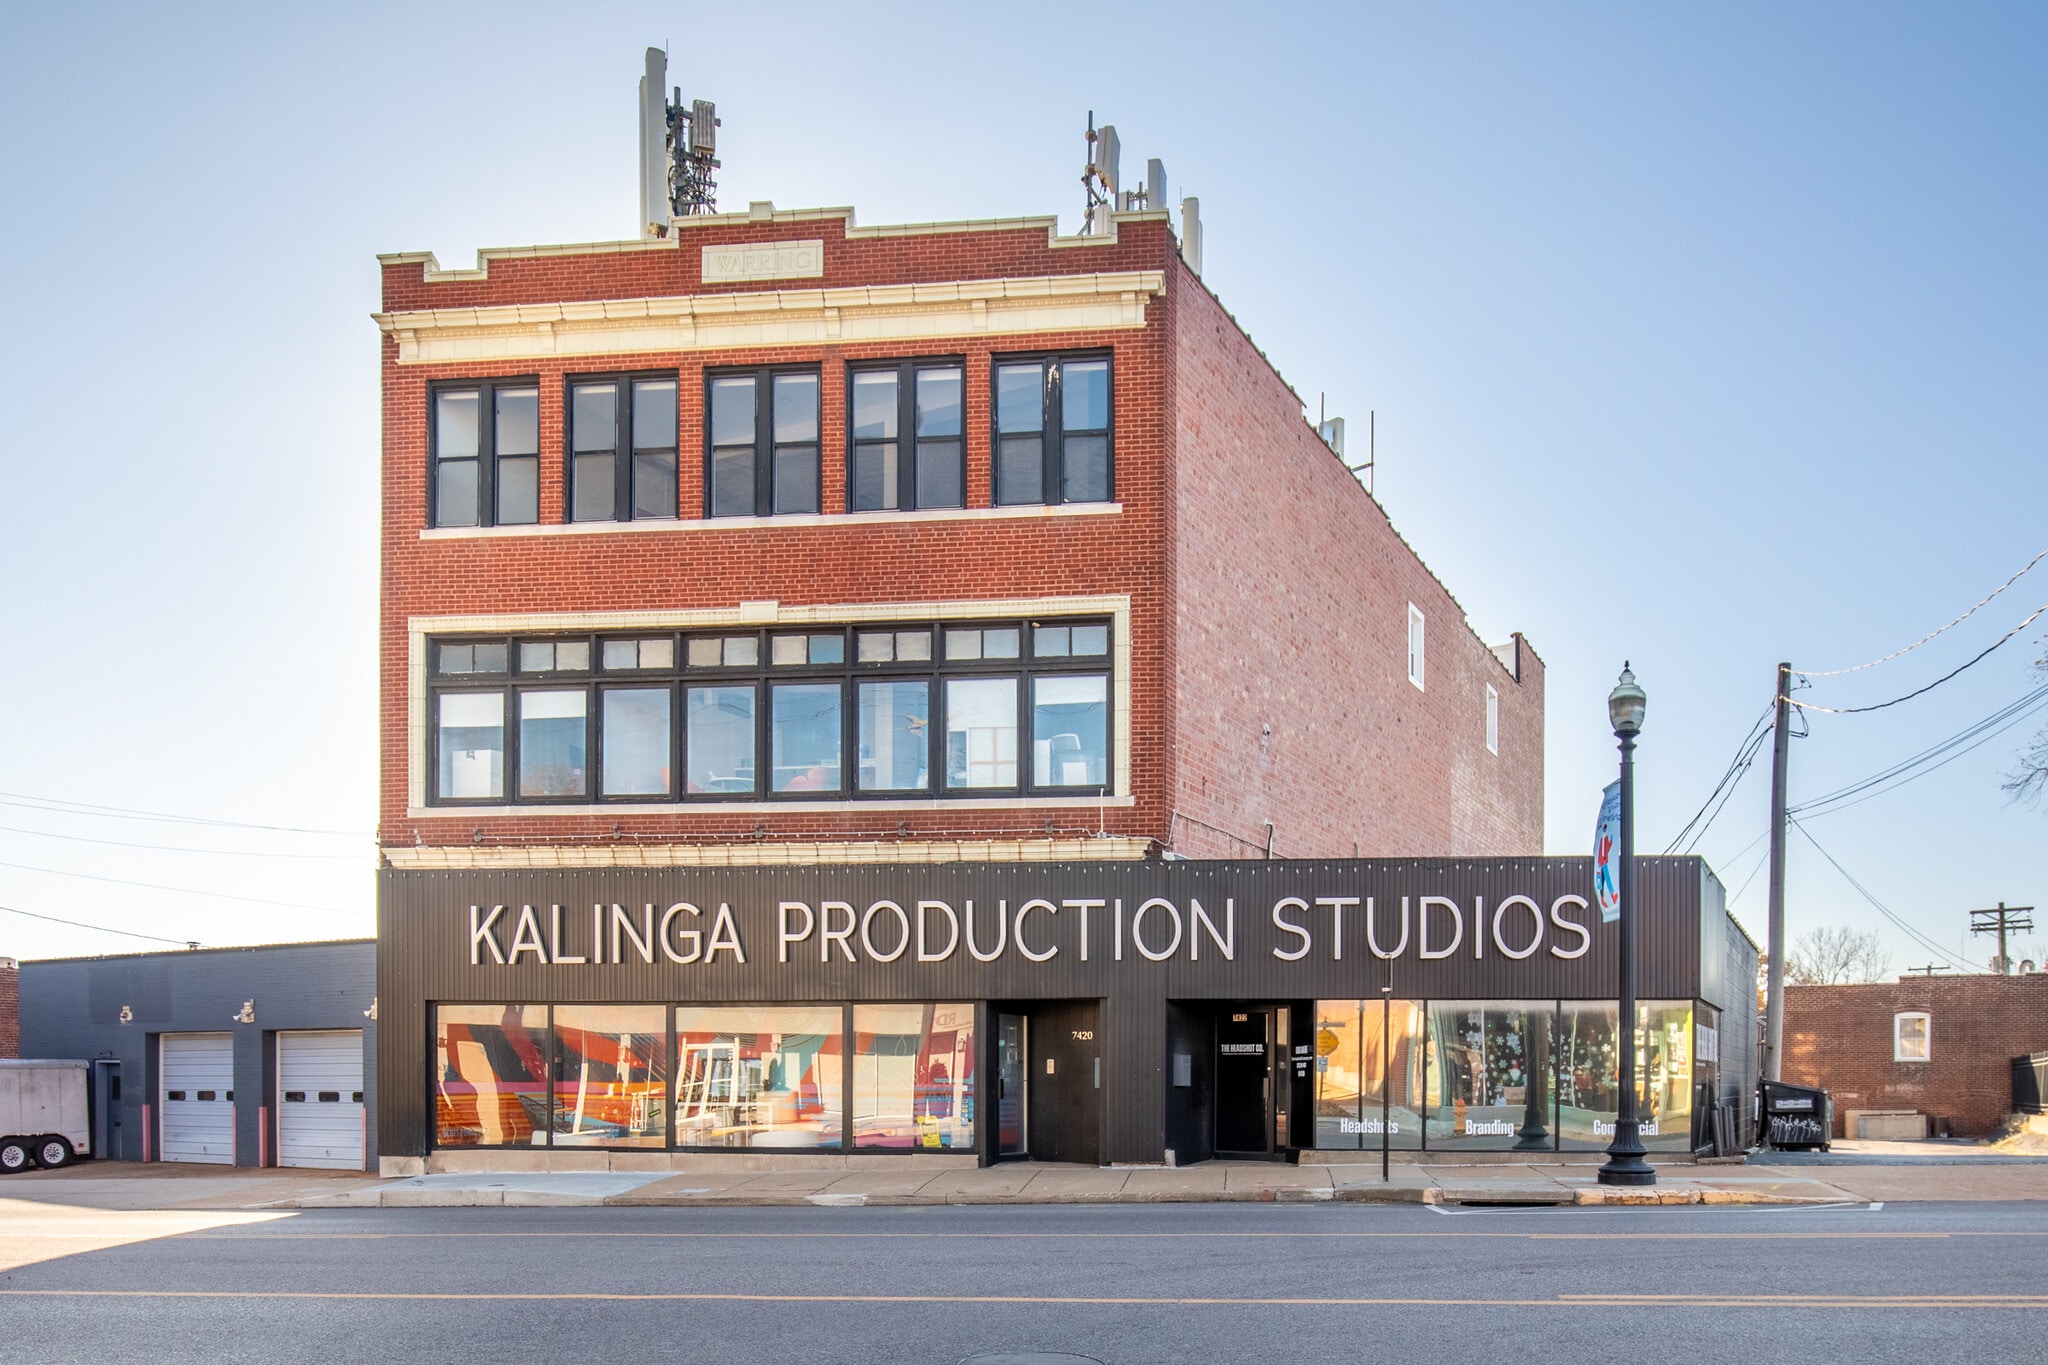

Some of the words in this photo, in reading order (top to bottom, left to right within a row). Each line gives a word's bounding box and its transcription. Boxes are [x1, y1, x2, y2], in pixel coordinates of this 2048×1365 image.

[713, 252, 811, 273] WARRING
[470, 902, 748, 966] KALINGA
[778, 897, 1234, 963] PRODUCTION
[1272, 894, 1591, 960] STUDIOS
[1071, 1030, 1093, 1040] 7420
[1221, 1044, 1229, 1052] THE
[1230, 1044, 1255, 1052] HEADSHOT
[1256, 1044, 1264, 1052] CO.
[1465, 1119, 1514, 1137] Branding
[1593, 1119, 1659, 1136] Comcial
